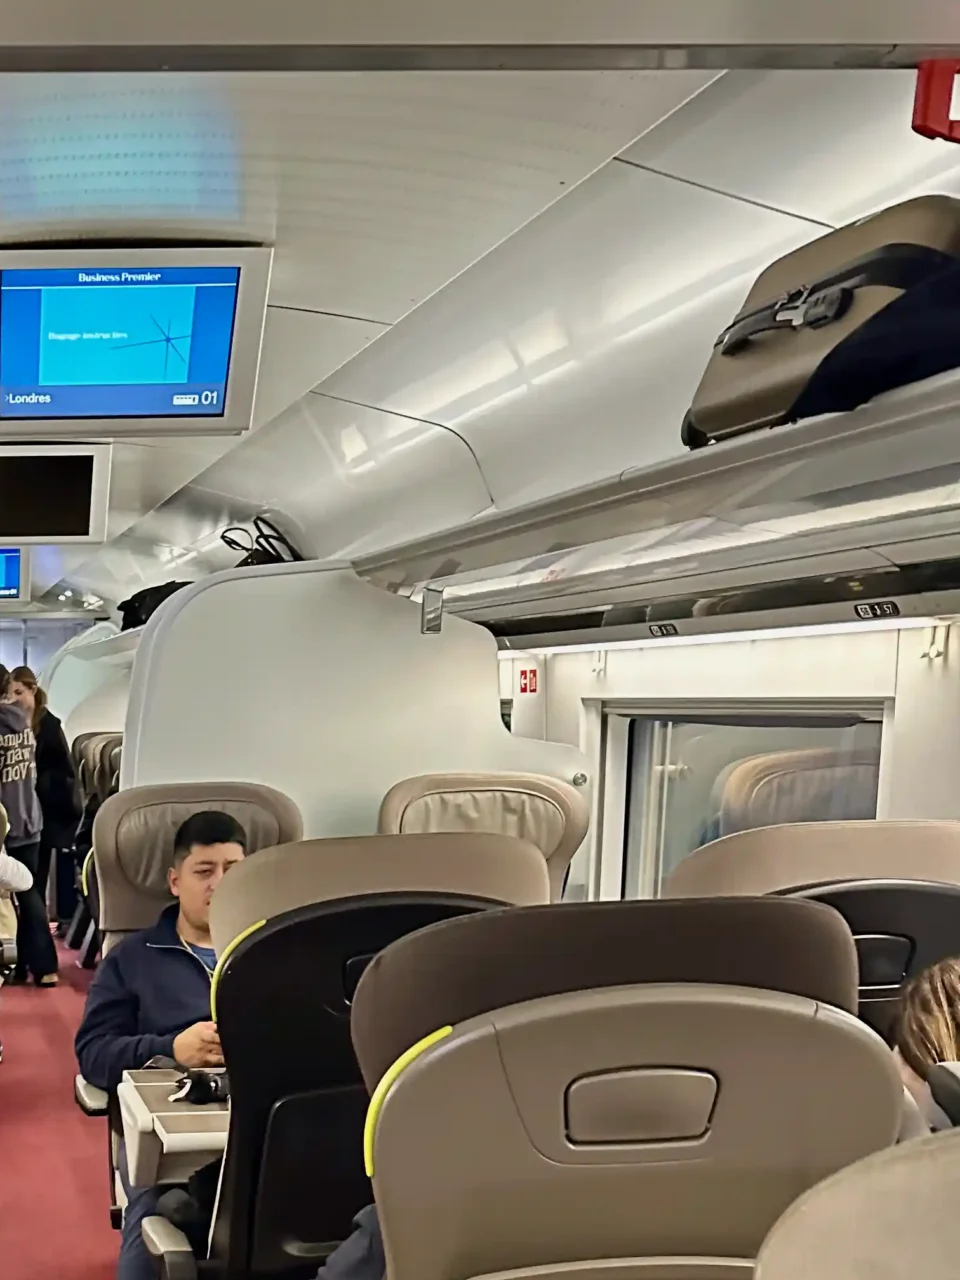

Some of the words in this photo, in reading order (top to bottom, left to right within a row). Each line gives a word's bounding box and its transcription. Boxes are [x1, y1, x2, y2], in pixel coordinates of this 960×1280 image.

[78, 272, 120, 282] Business
[121, 271, 161, 282] Premier
[9, 392, 52, 404] Londres
[201, 390, 218, 405] 01
